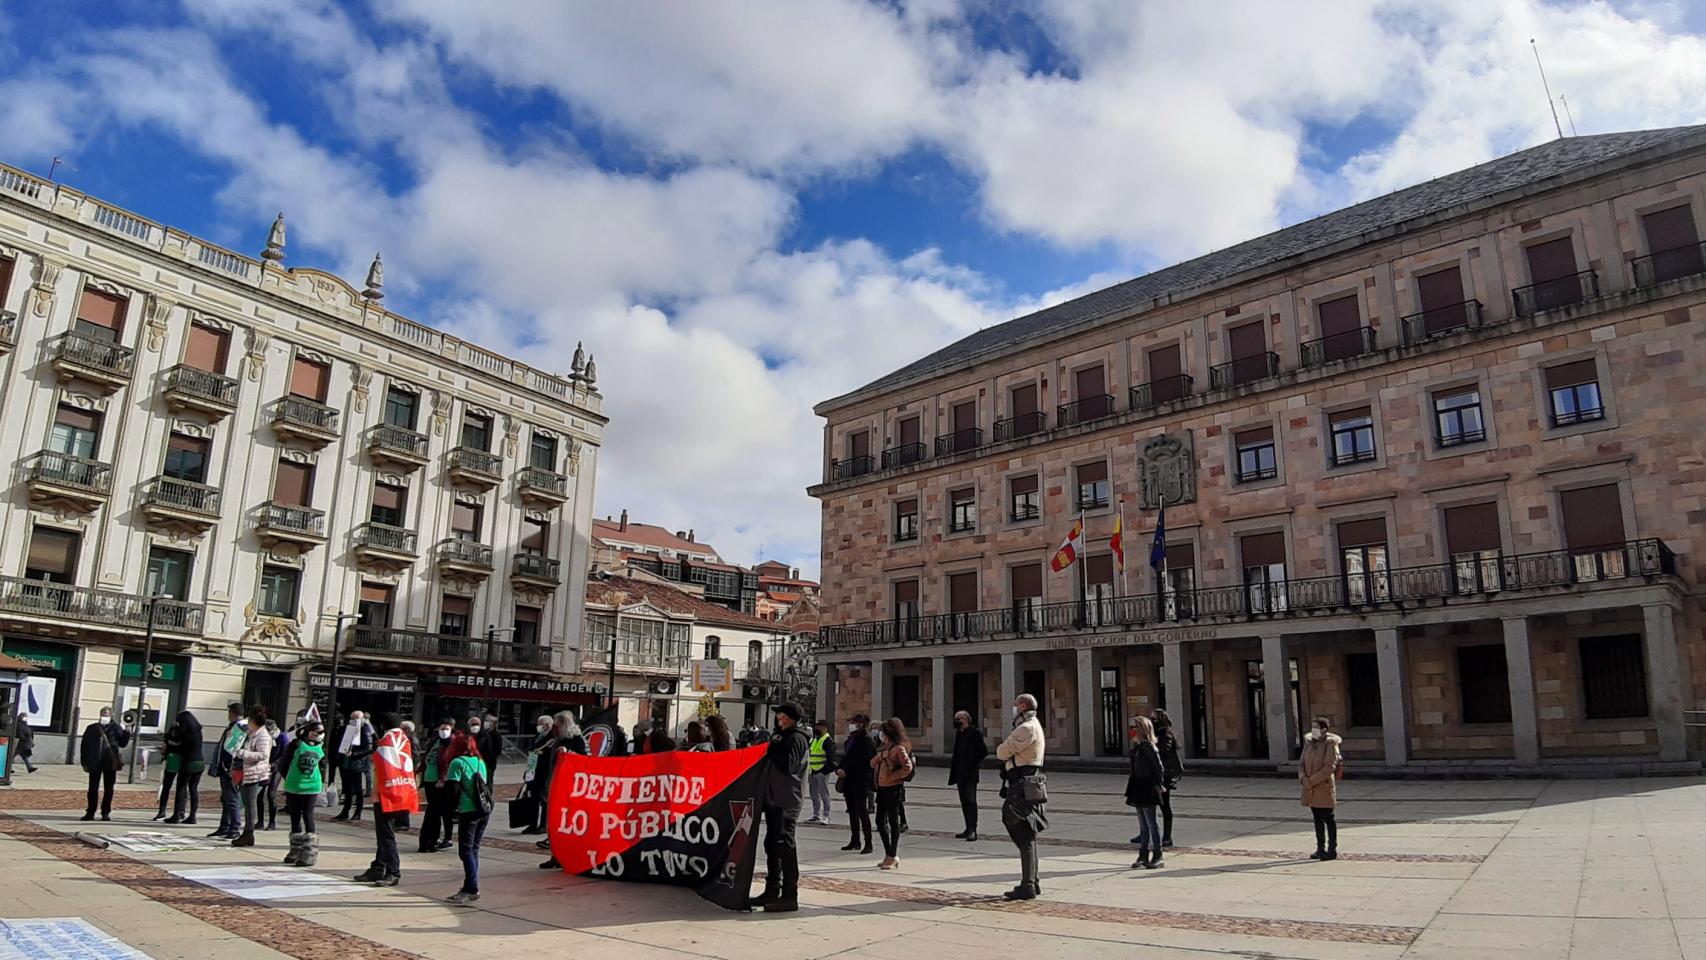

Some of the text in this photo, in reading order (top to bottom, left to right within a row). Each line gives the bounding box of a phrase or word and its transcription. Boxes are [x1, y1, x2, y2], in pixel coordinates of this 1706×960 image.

[457, 675, 539, 690] FERRETERIA
[571, 772, 705, 806] DEFIENDE
[558, 807, 720, 845] LO PÚBLICO
[587, 850, 625, 877] LO
